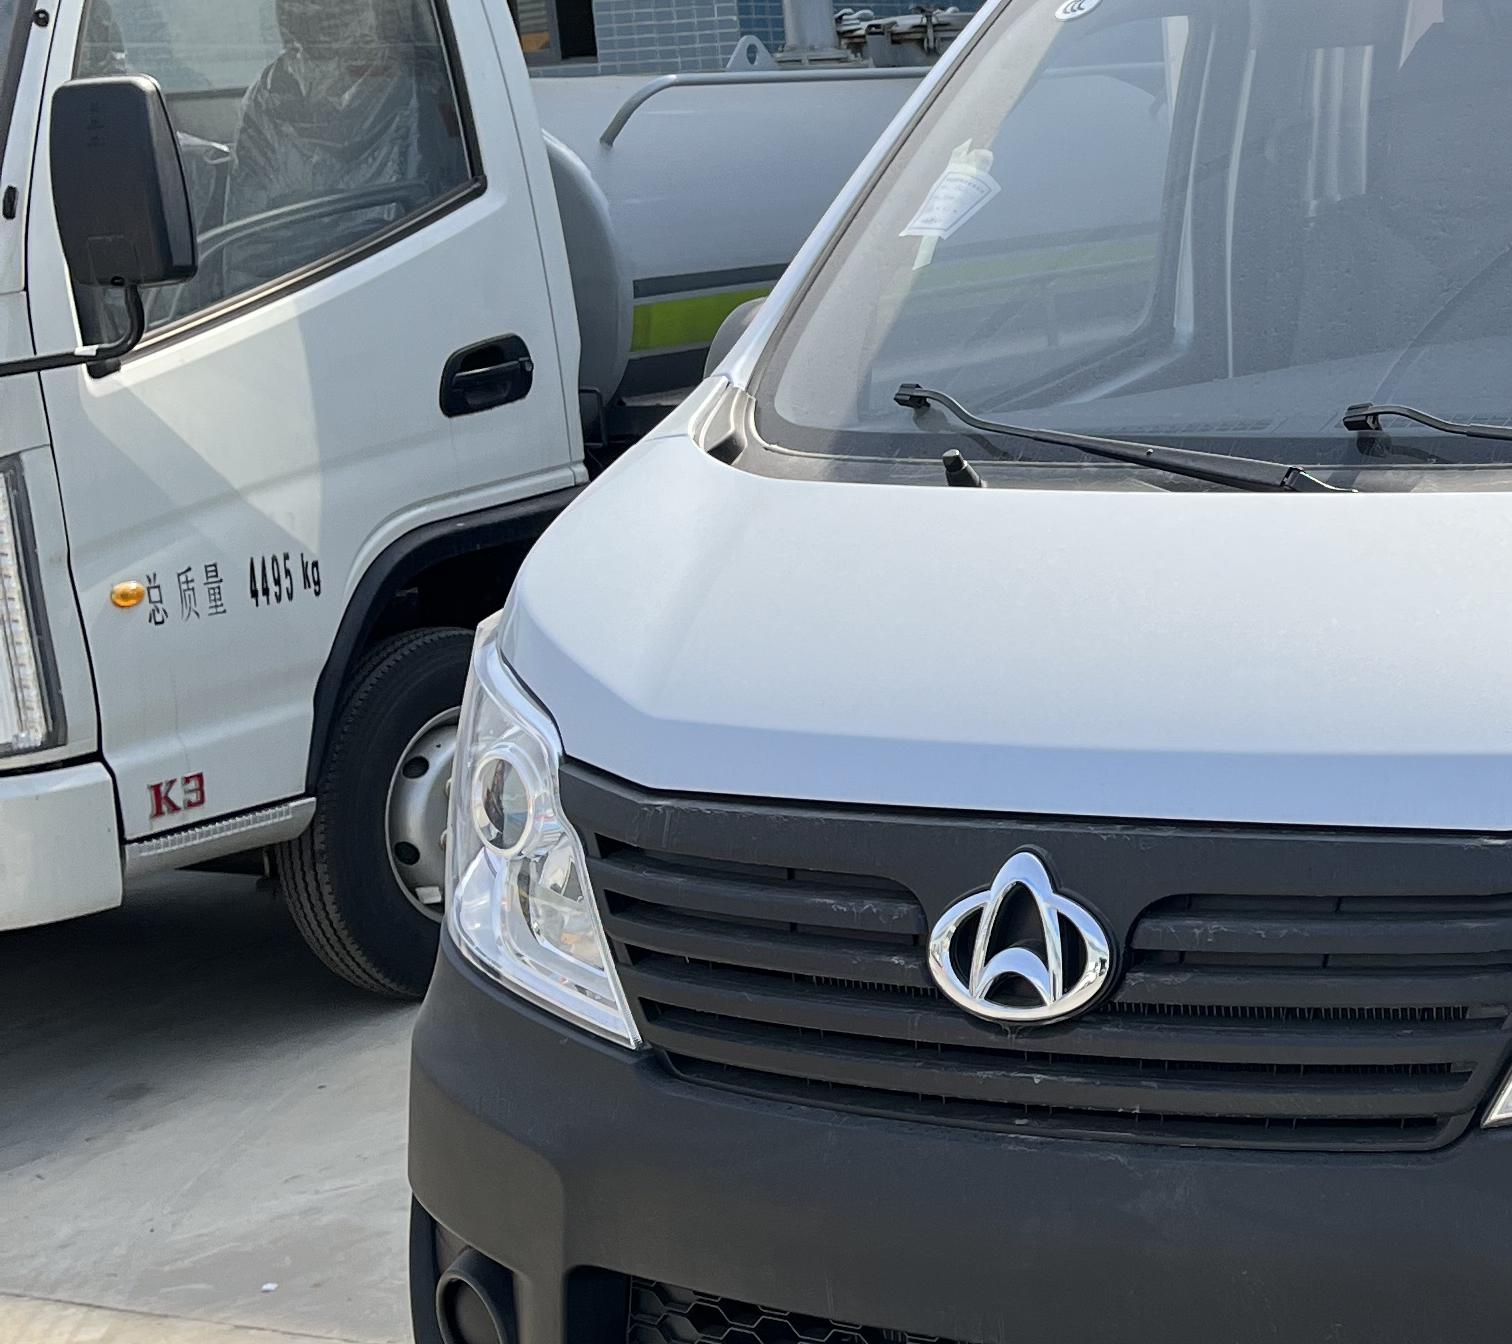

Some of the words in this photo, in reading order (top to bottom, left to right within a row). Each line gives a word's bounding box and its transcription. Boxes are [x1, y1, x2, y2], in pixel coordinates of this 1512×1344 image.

[145, 561, 227, 627] 总质量
[249, 551, 294, 607] 4495
[300, 552, 322, 598] kg
[148, 771, 206, 819] K3
